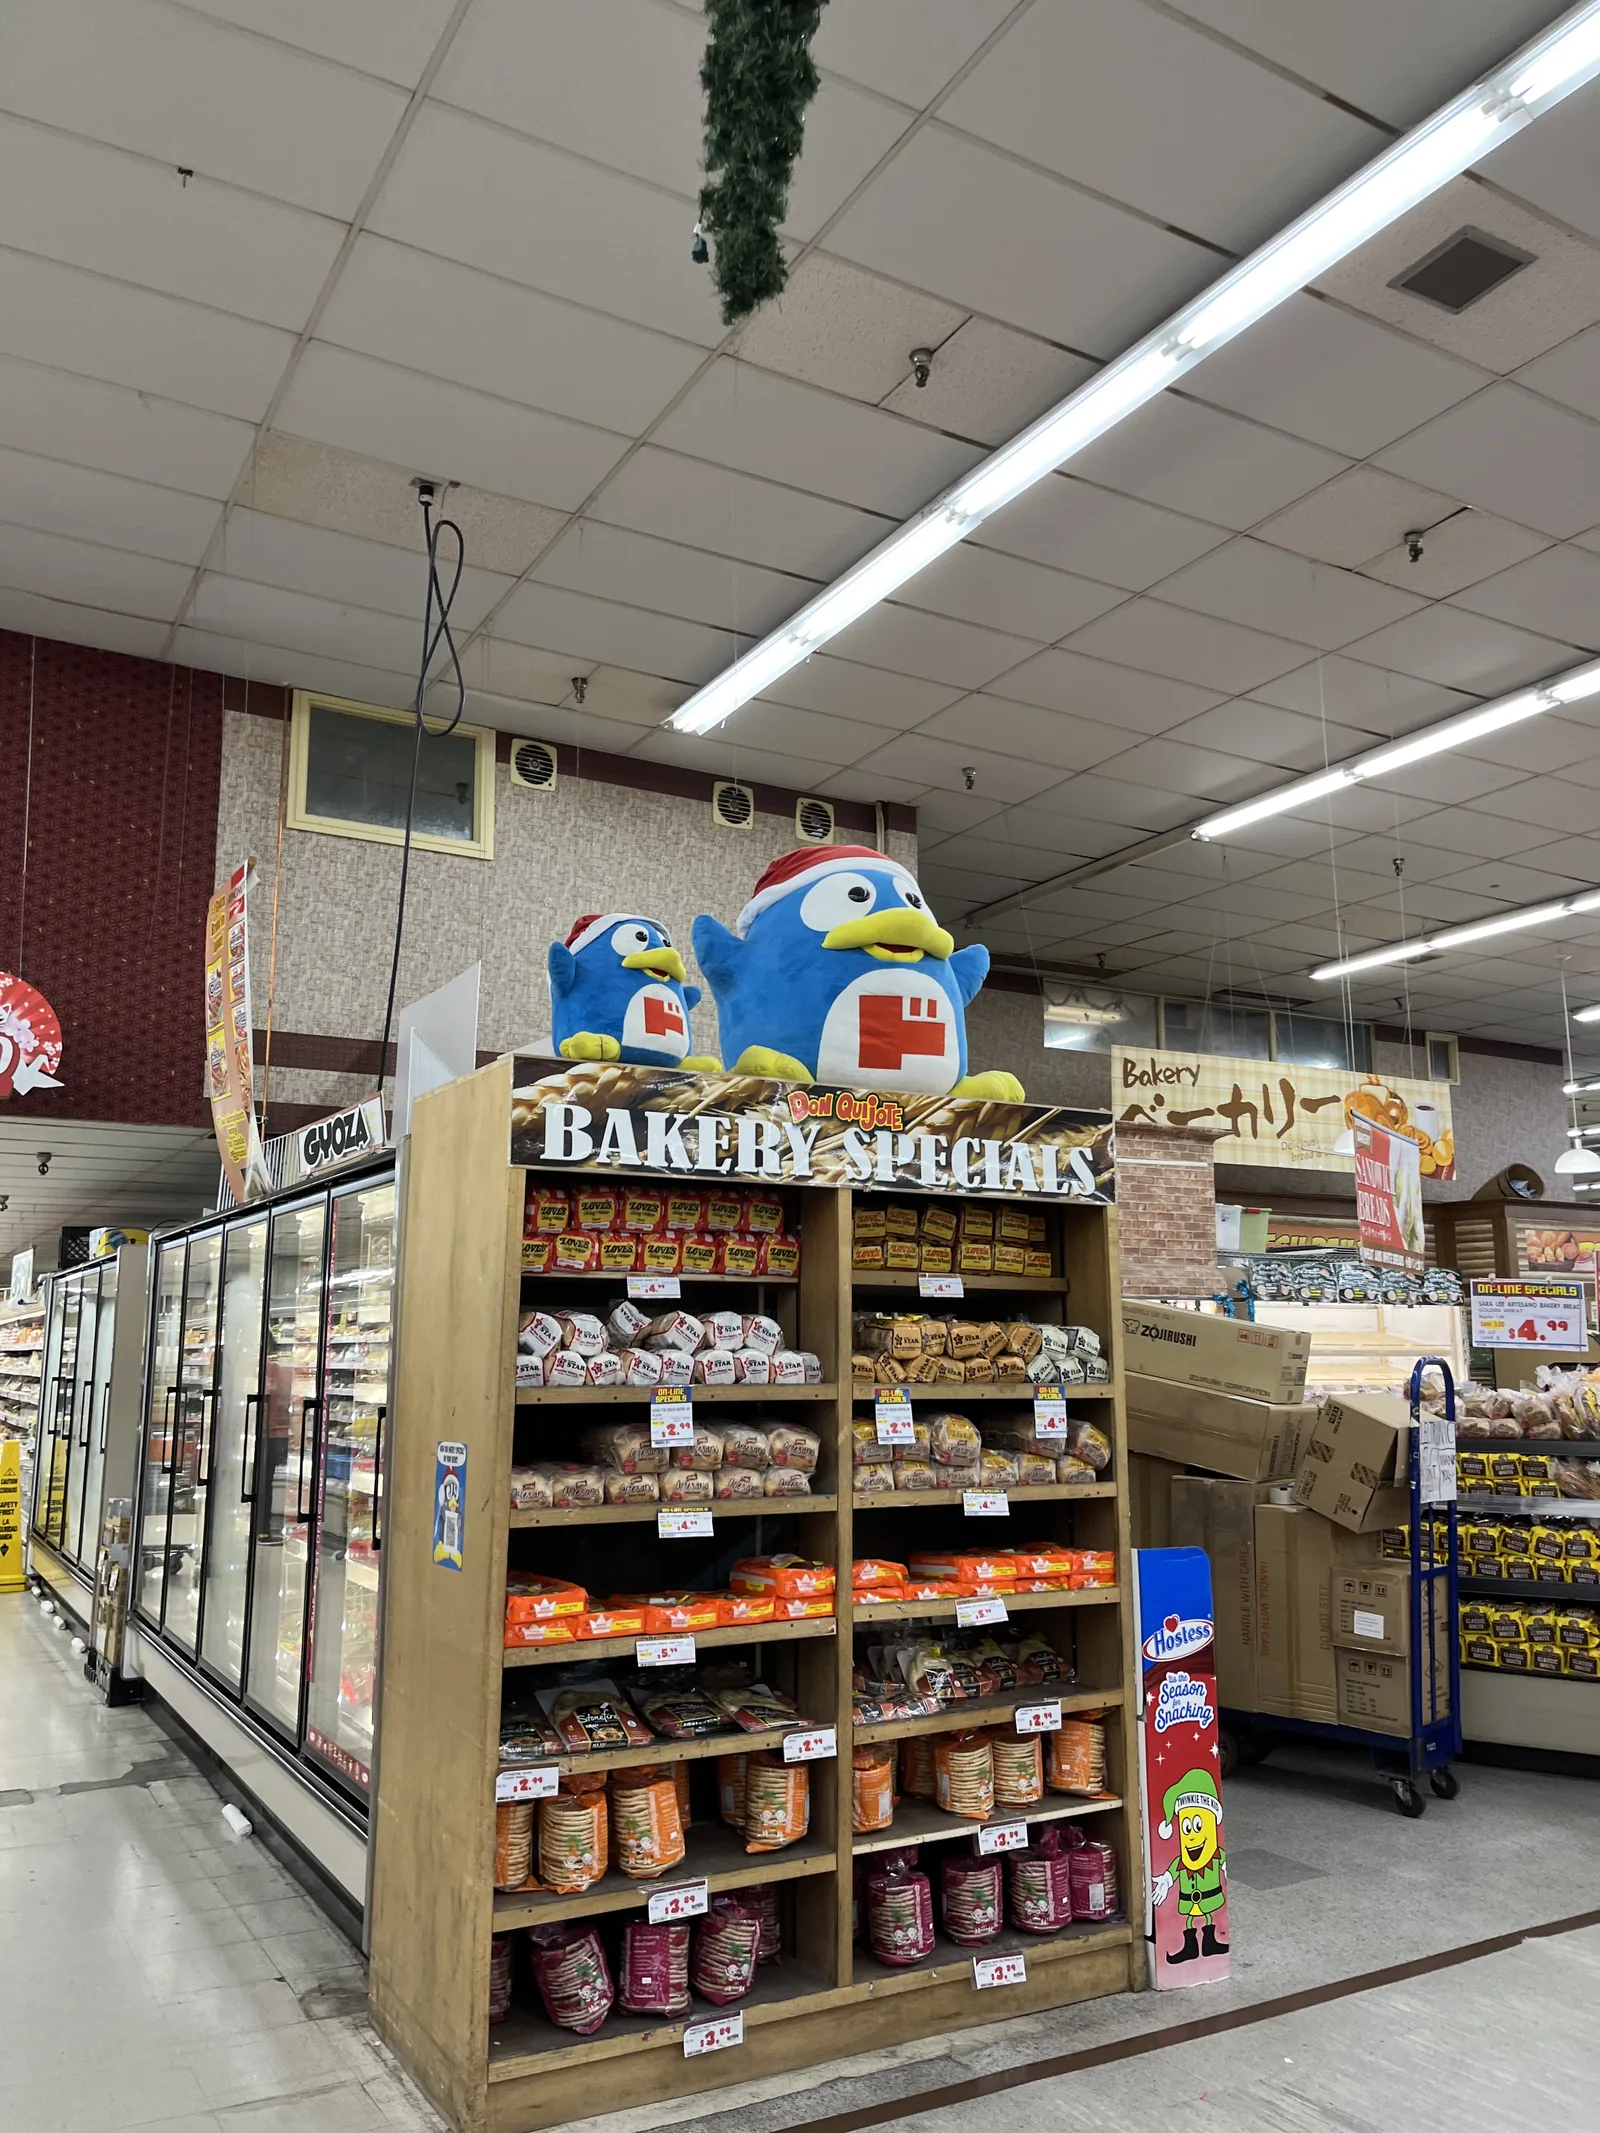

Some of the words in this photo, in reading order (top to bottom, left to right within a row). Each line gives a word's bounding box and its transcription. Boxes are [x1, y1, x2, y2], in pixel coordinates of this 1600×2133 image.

[1123, 1057, 1200, 1088] Bakery
[787, 1090, 834, 1124] DON
[1120, 1078, 1341, 1139] ベーカリー
[304, 1106, 368, 1166] GYOZA
[539, 1104, 827, 1176] BAKERY
[840, 1130, 1096, 1197] SPECIALS
[1292, 1152, 1314, 1162] bread
[541, 1206, 566, 1216] LOVE'S
[581, 1200, 612, 1210] LOVE'S
[629, 1201, 659, 1212] LOVE'S
[671, 1201, 699, 1212] LOVE'S
[711, 1202, 739, 1214] LOVE'S
[753, 1204, 780, 1216] LOVE'S
[1358, 1190, 1391, 1227] BREADS
[559, 1237, 590, 1249] LOVE'S
[604, 1244, 633, 1254] LOVE'S
[647, 1244, 677, 1255] LOVE'S
[686, 1246, 714, 1258] LOVE'S
[728, 1247, 756, 1258] LOVE'S
[770, 1247, 798, 1258] LOVE'S
[1477, 1284, 1523, 1294] ON-LINE
[1525, 1285, 1577, 1296] SPECIALS
[762, 1328, 776, 1338] STAR
[1141, 1324, 1196, 1347] ZOJIRUSHI
[1509, 1320, 1568, 1341] $4.99
[1023, 1332, 1034, 1346] STAR
[566, 1361, 585, 1371] STAR
[641, 1364, 658, 1374] STAR
[662, 1422, 690, 1438] $2.99
[886, 1422, 911, 1435] $2.99
[734, 1441, 766, 1455] Artesano
[783, 1441, 816, 1456] Artesano
[563, 1486, 600, 1498] Artesano
[620, 1483, 654, 1494] Artesano
[676, 1480, 709, 1491] Artesano
[728, 1478, 758, 1492] Artesano
[1240, 1550, 1250, 1574] CARE
[1259, 1561, 1269, 1602] HANDLE
[1241, 1576, 1251, 1603] WITH
[1260, 1605, 1270, 1630] WITH
[1320, 1611, 1330, 1634] NOT
[1242, 1606, 1251, 1645] HANDLE
[1154, 1624, 1210, 1658] Hostess
[1320, 1636, 1330, 1650] DO
[657, 1648, 677, 1659] $5.99
[1160, 1682, 1205, 1704] Season
[1172, 1698, 1181, 1708] for
[576, 1709, 619, 1724] Stonefire
[1029, 1712, 1052, 1726] $2.99
[1157, 1702, 1212, 1730] Snacking
[799, 1738, 822, 1753] $2.99
[513, 1777, 543, 1792] $2.99
[1177, 1795, 1200, 1807] TWINKIE
[1200, 1795, 1210, 1806] THE
[1211, 1798, 1219, 1812] KID
[994, 1831, 1019, 1847] $3.89
[665, 1895, 695, 1914] $3.89
[991, 1964, 1016, 1980] $3.89
[700, 2027, 730, 2047] $3.89
